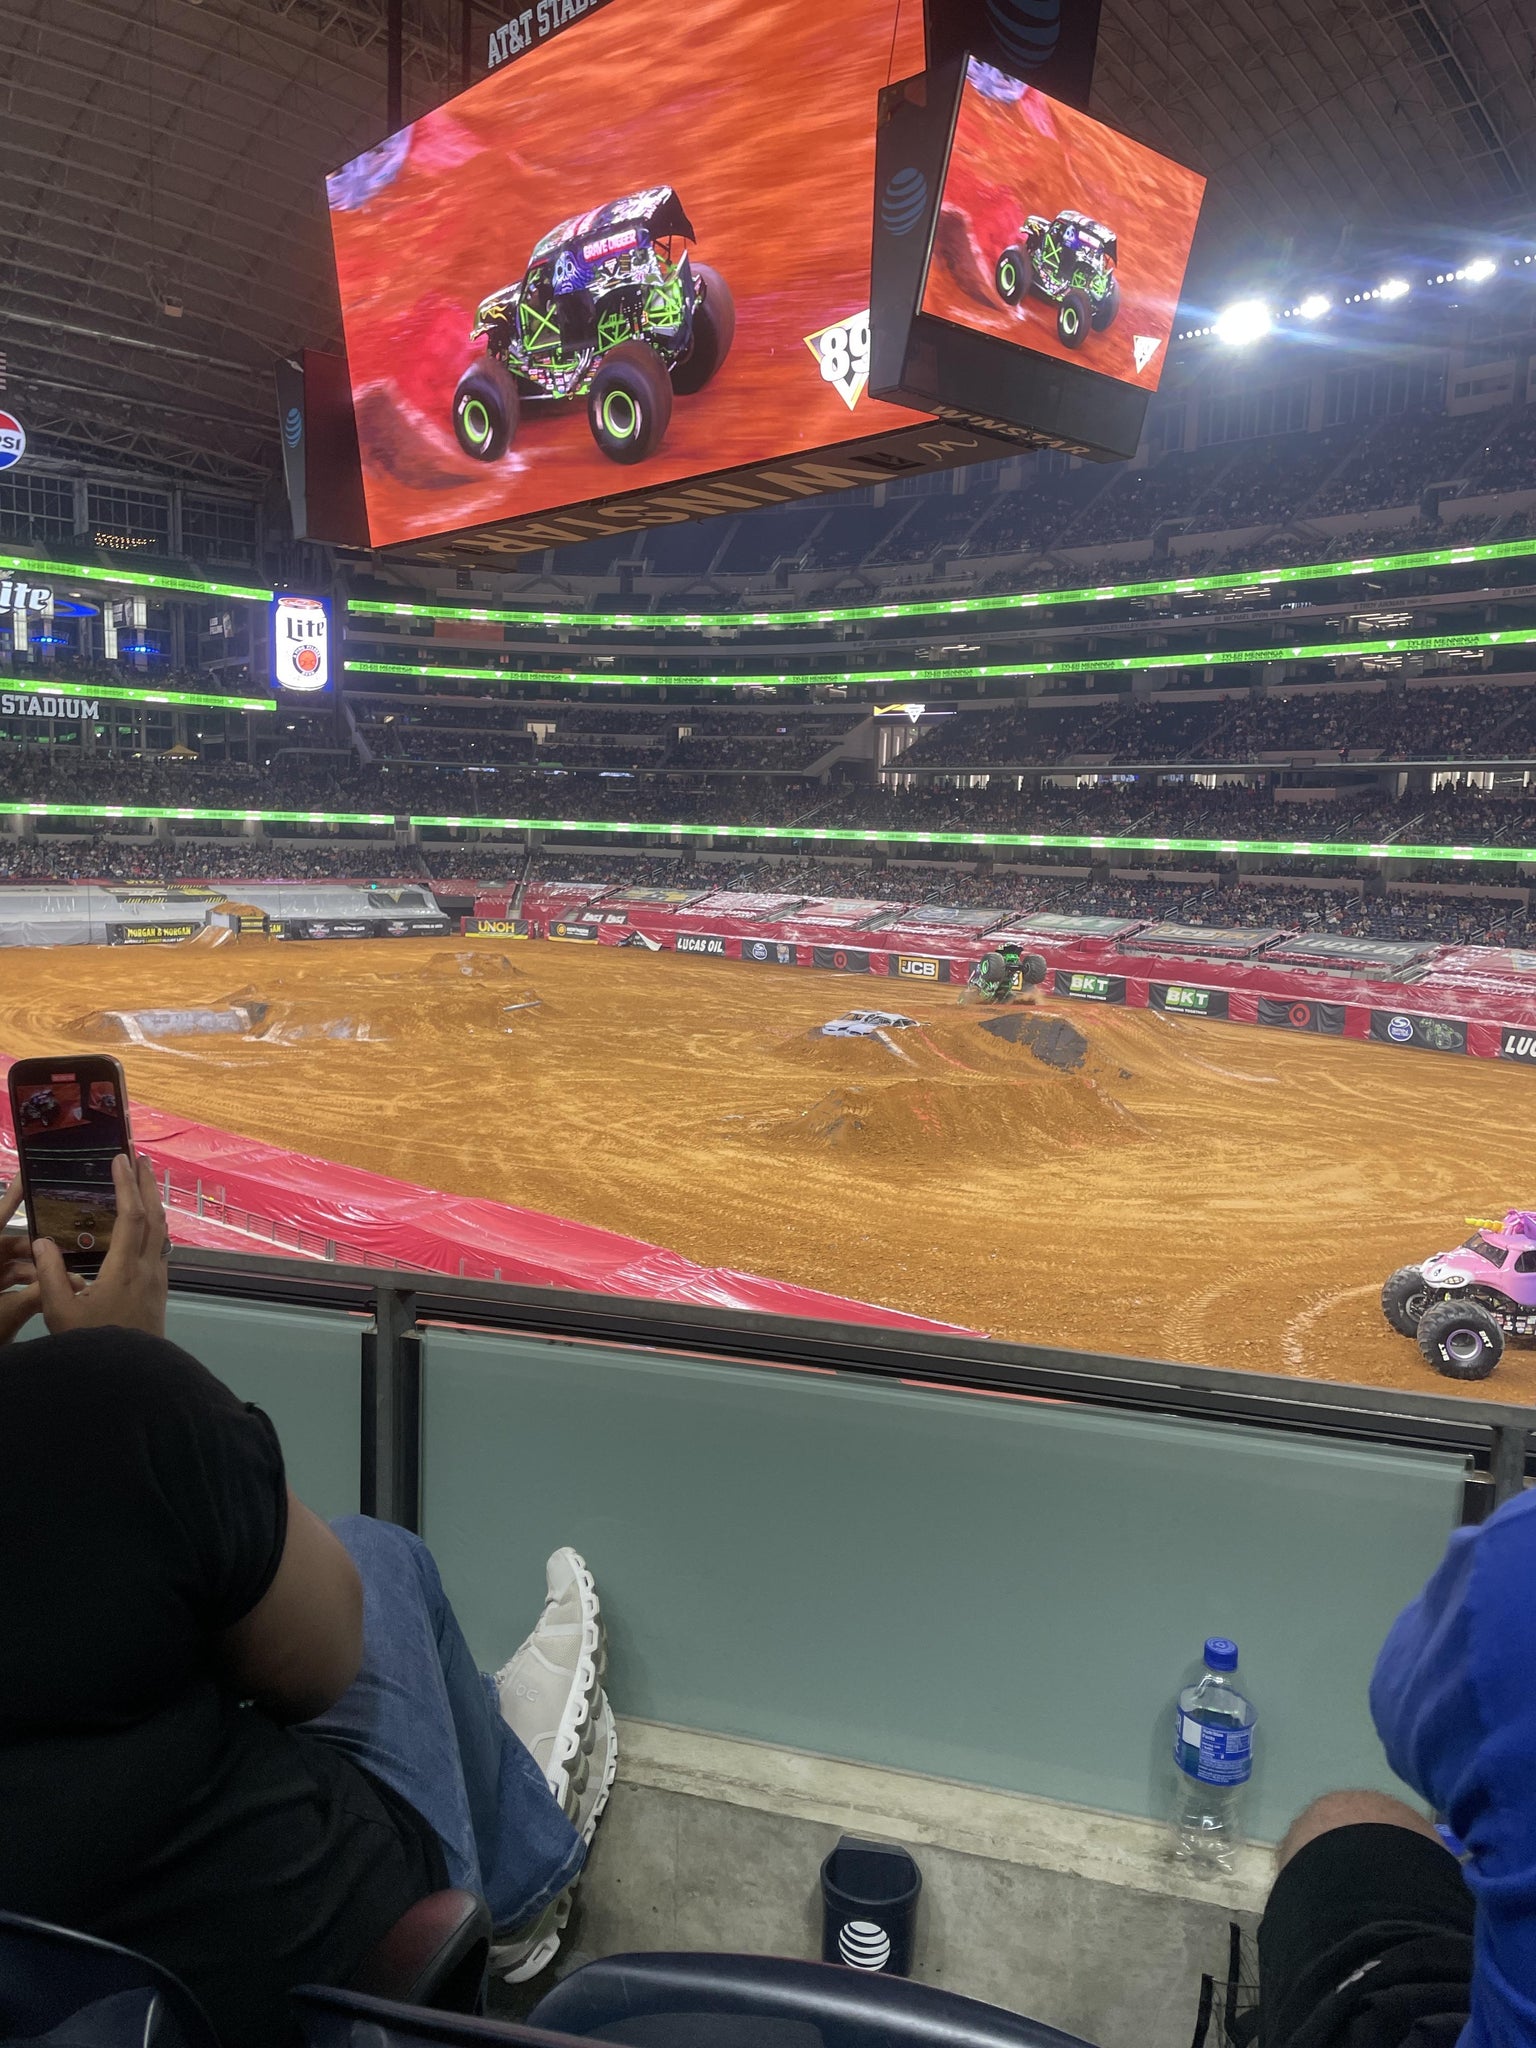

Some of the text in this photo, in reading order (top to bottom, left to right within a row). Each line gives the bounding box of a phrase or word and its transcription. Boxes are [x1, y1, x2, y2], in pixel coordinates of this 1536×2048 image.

[487, 0, 598, 69] AT&T STAD
[820, 317, 871, 382] 89
[287, 617, 325, 642] Lite
[1, 694, 100, 720] STADIUM
[127, 928, 156, 938] MORGAN
[163, 926, 192, 936] MORGAN
[478, 920, 516, 933] UNOH
[677, 938, 724, 953] LUCAS OIL
[901, 960, 936, 976] JCB
[1070, 975, 1109, 992] BKT
[1166, 989, 1209, 1006] BKT
[1479, 1330, 1494, 1349] BKT
